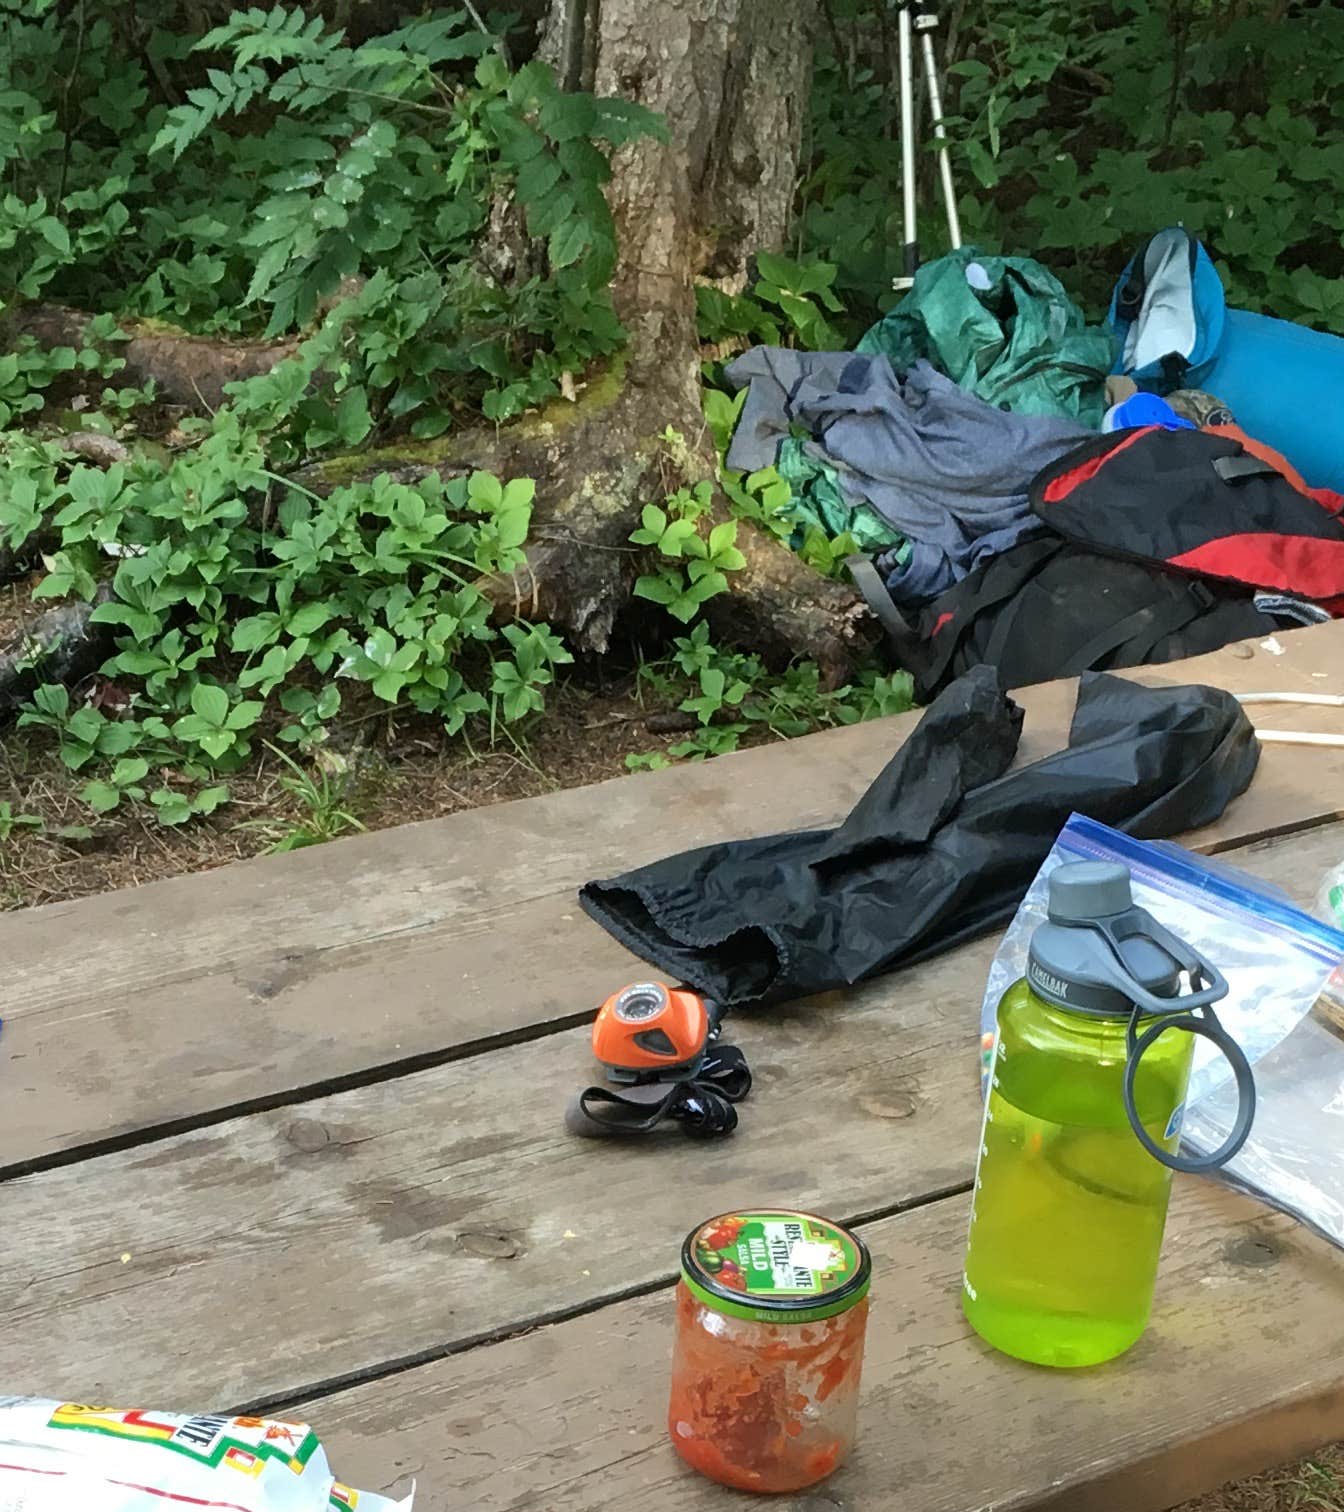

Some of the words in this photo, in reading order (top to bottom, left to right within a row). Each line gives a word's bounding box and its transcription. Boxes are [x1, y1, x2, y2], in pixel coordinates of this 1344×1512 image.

[1031, 961, 1070, 998] CAMELBAK
[737, 1244, 750, 1265] SALSA
[748, 1238, 768, 1270] MILD
[771, 1240, 789, 1267] STYLE
